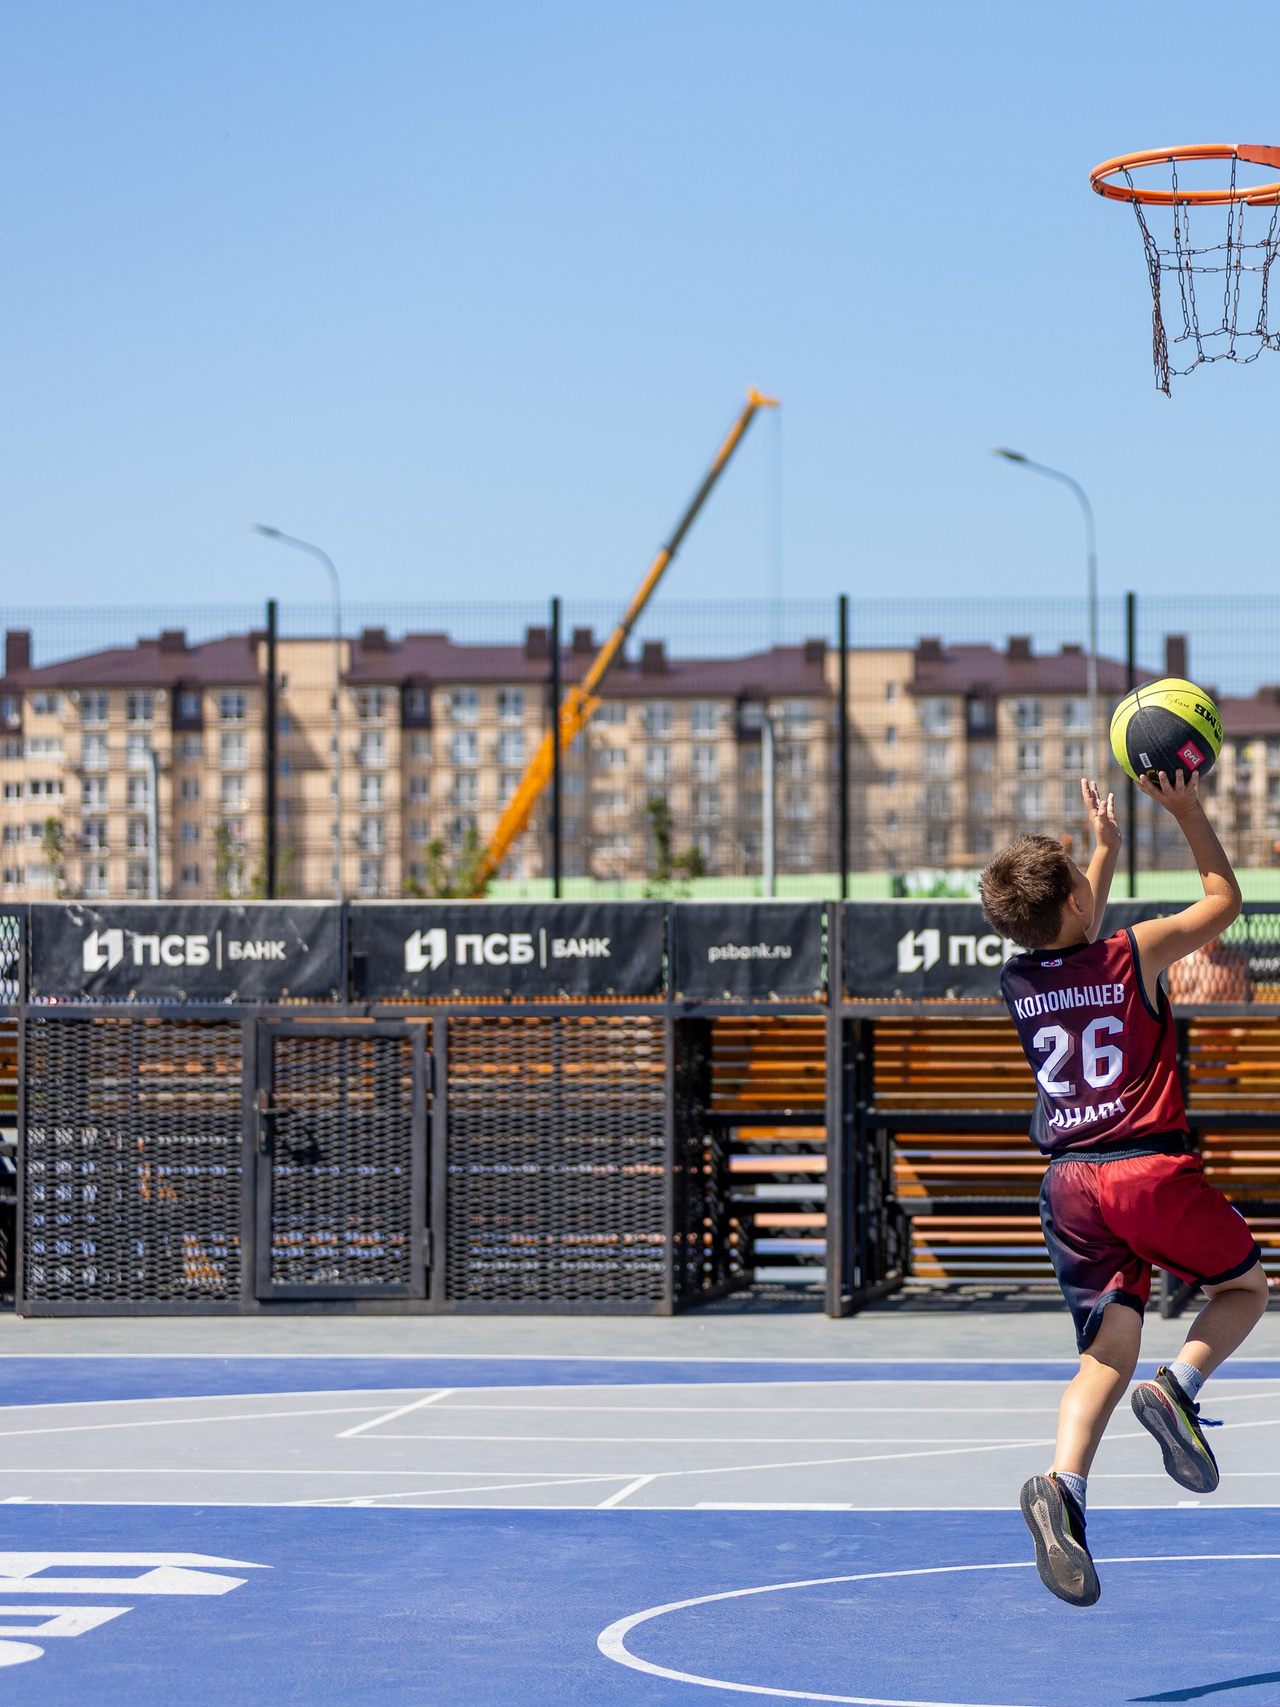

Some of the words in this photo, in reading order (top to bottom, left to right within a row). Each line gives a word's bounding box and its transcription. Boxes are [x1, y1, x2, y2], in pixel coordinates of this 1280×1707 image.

[133, 934, 210, 966] ПСБ
[228, 941, 286, 960] БАНК
[456, 933, 534, 965] ПСБ
[552, 937, 611, 958] БАНК
[708, 943, 792, 963] psbank.ru
[1014, 983, 1125, 1020] КОЛОМЫЦЕВ
[1032, 1015, 1129, 1098] 26
